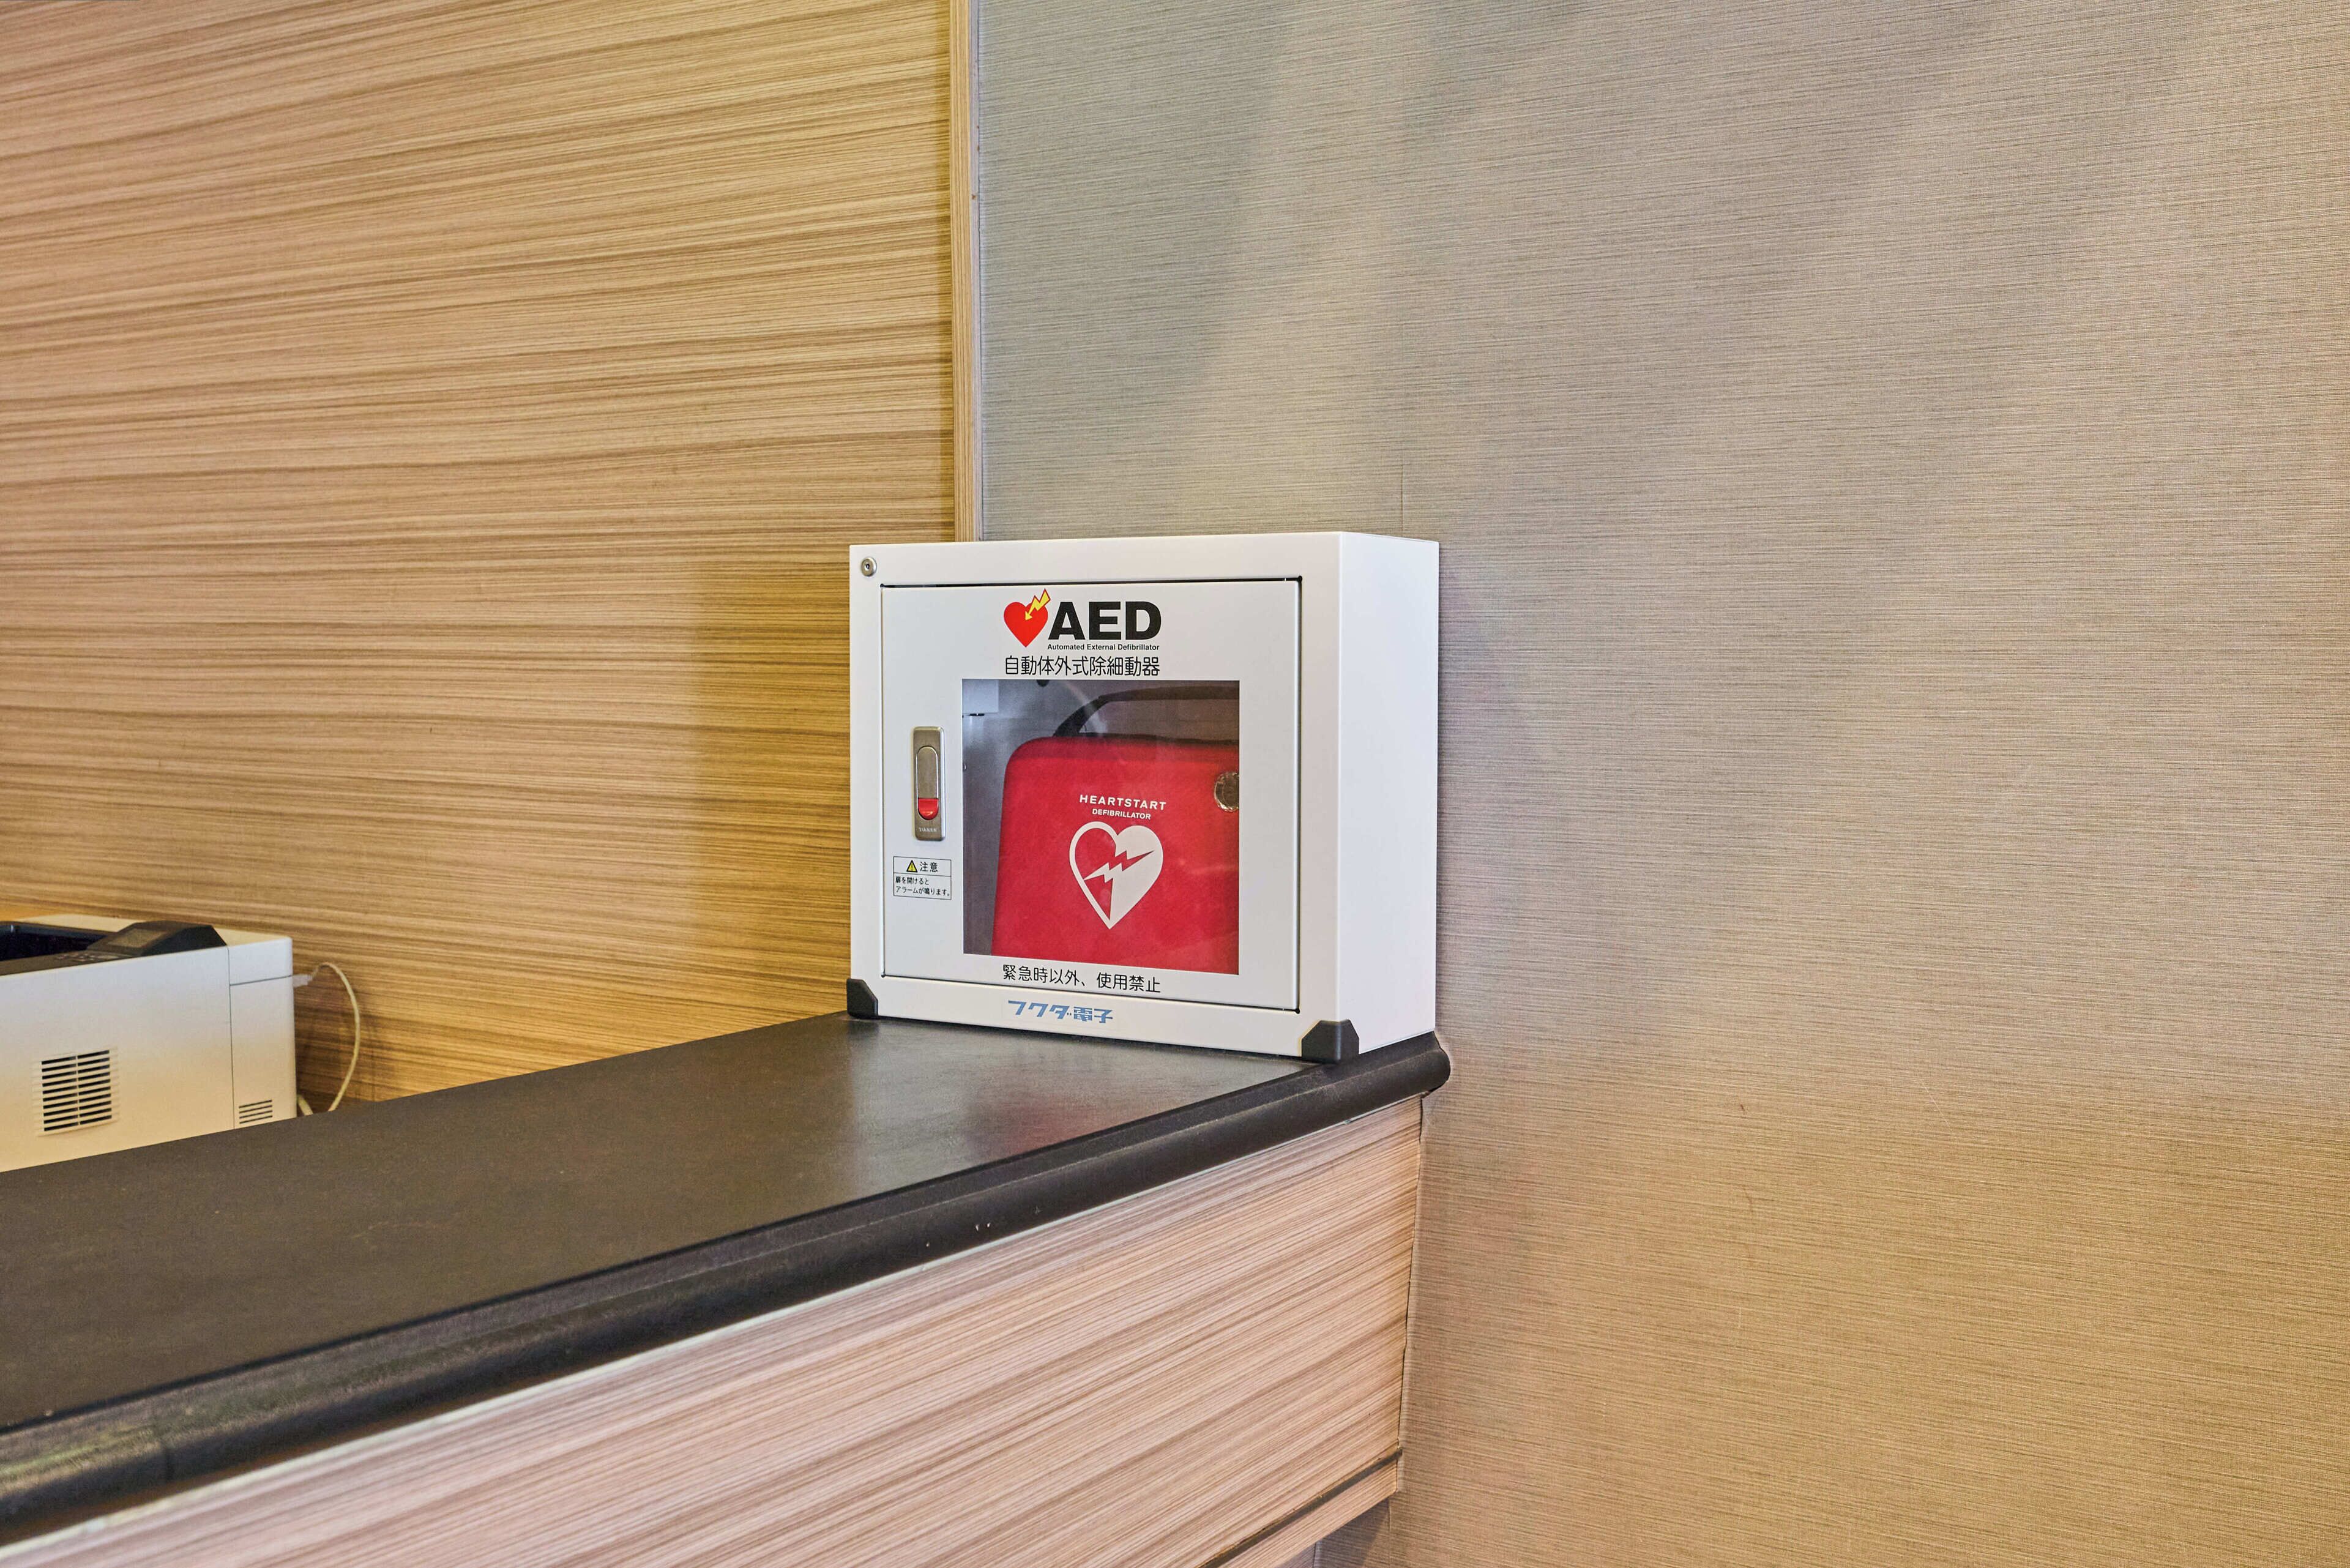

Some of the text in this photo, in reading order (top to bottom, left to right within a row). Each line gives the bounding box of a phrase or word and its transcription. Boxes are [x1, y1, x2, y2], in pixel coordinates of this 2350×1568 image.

[1048, 601, 1162, 640] AED
[1005, 655, 1160, 676] 自動体外式除細動器
[1079, 794, 1166, 810] HEARTSTART
[1092, 808, 1151, 820] DEFIBRILLATOR
[920, 861, 938, 873] 注意
[895, 876, 930, 886] 扉を開けると
[895, 886, 950, 897] アラームが鳴ります。
[1002, 964, 1161, 993] 緊急時以外、使用禁止
[1008, 999, 1113, 1024] フクダ電子
